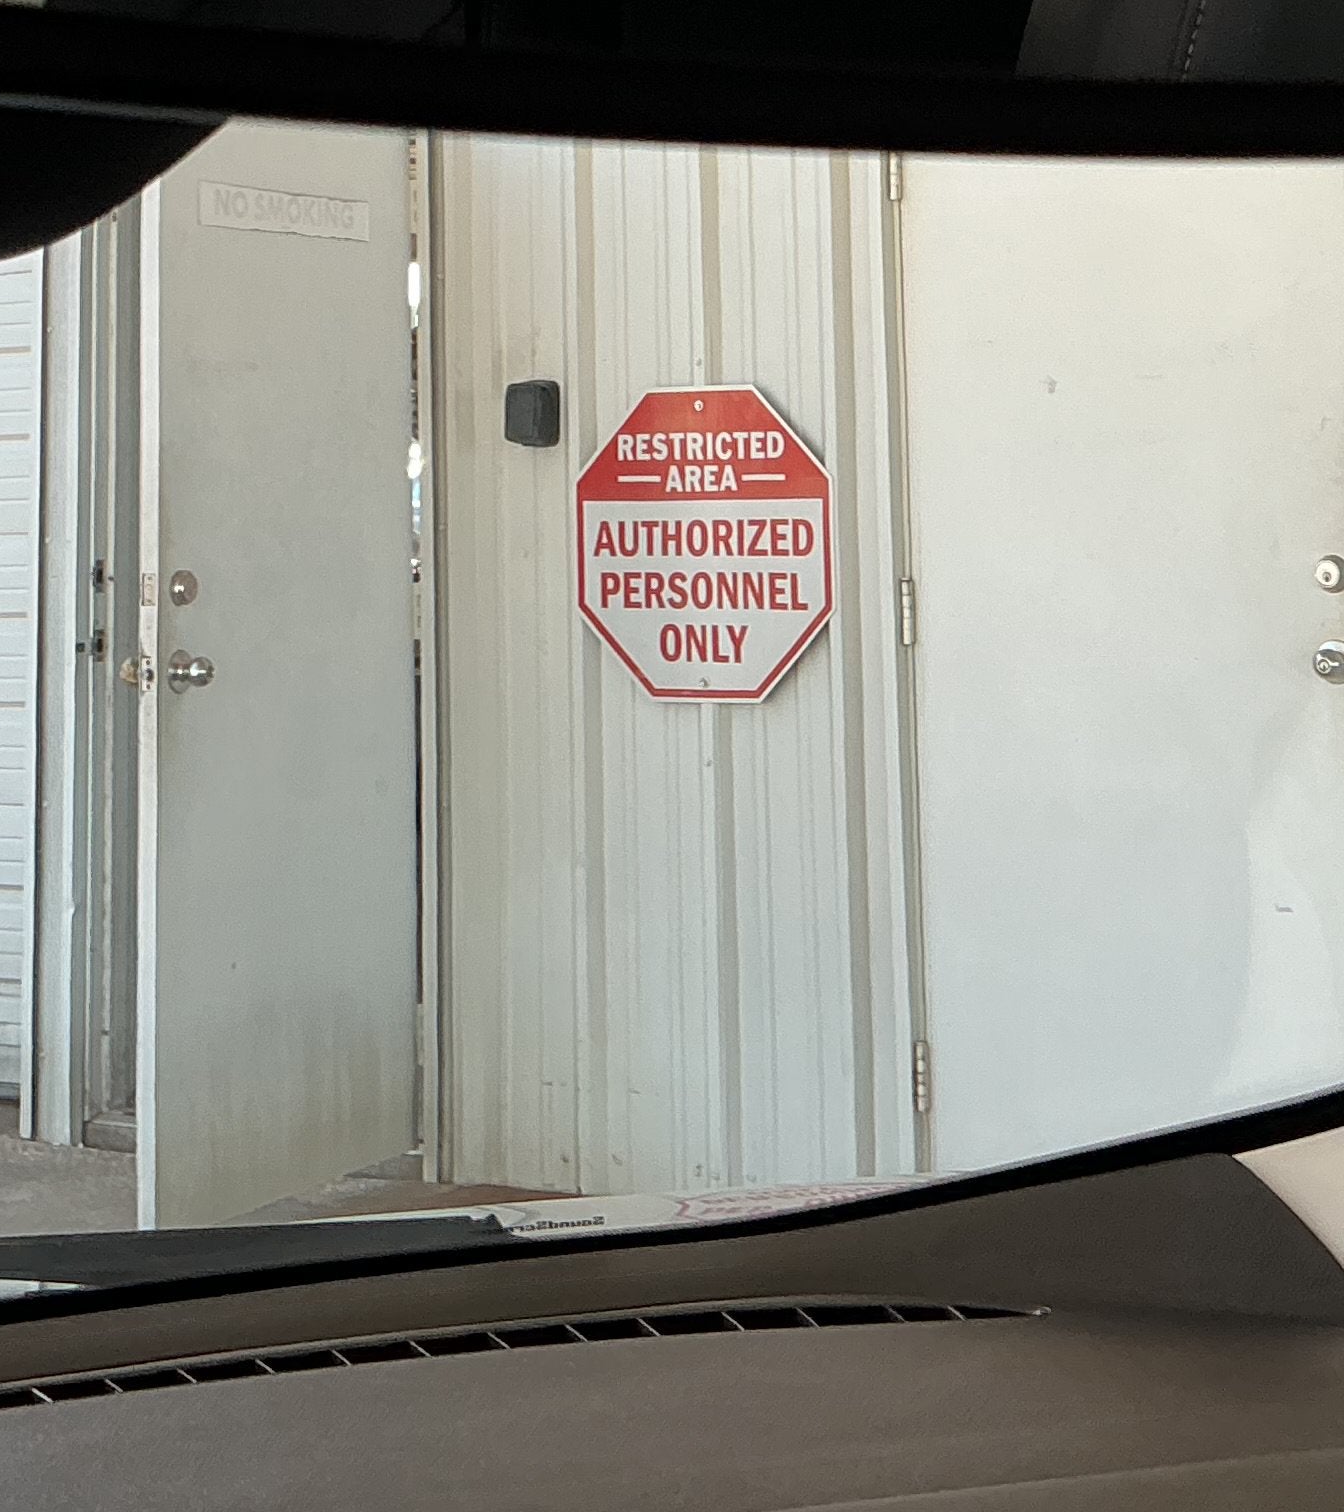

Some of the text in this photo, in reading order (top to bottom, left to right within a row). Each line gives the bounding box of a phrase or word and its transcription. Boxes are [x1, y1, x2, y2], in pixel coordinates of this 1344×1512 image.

[214, 189, 354, 229] NO SMOKING
[617, 431, 785, 461] RESTRICTED
[665, 464, 738, 493] AREA
[593, 518, 815, 558] AUTHORIZED
[600, 572, 808, 612] PERSONNEL
[660, 623, 749, 664] ONLY
